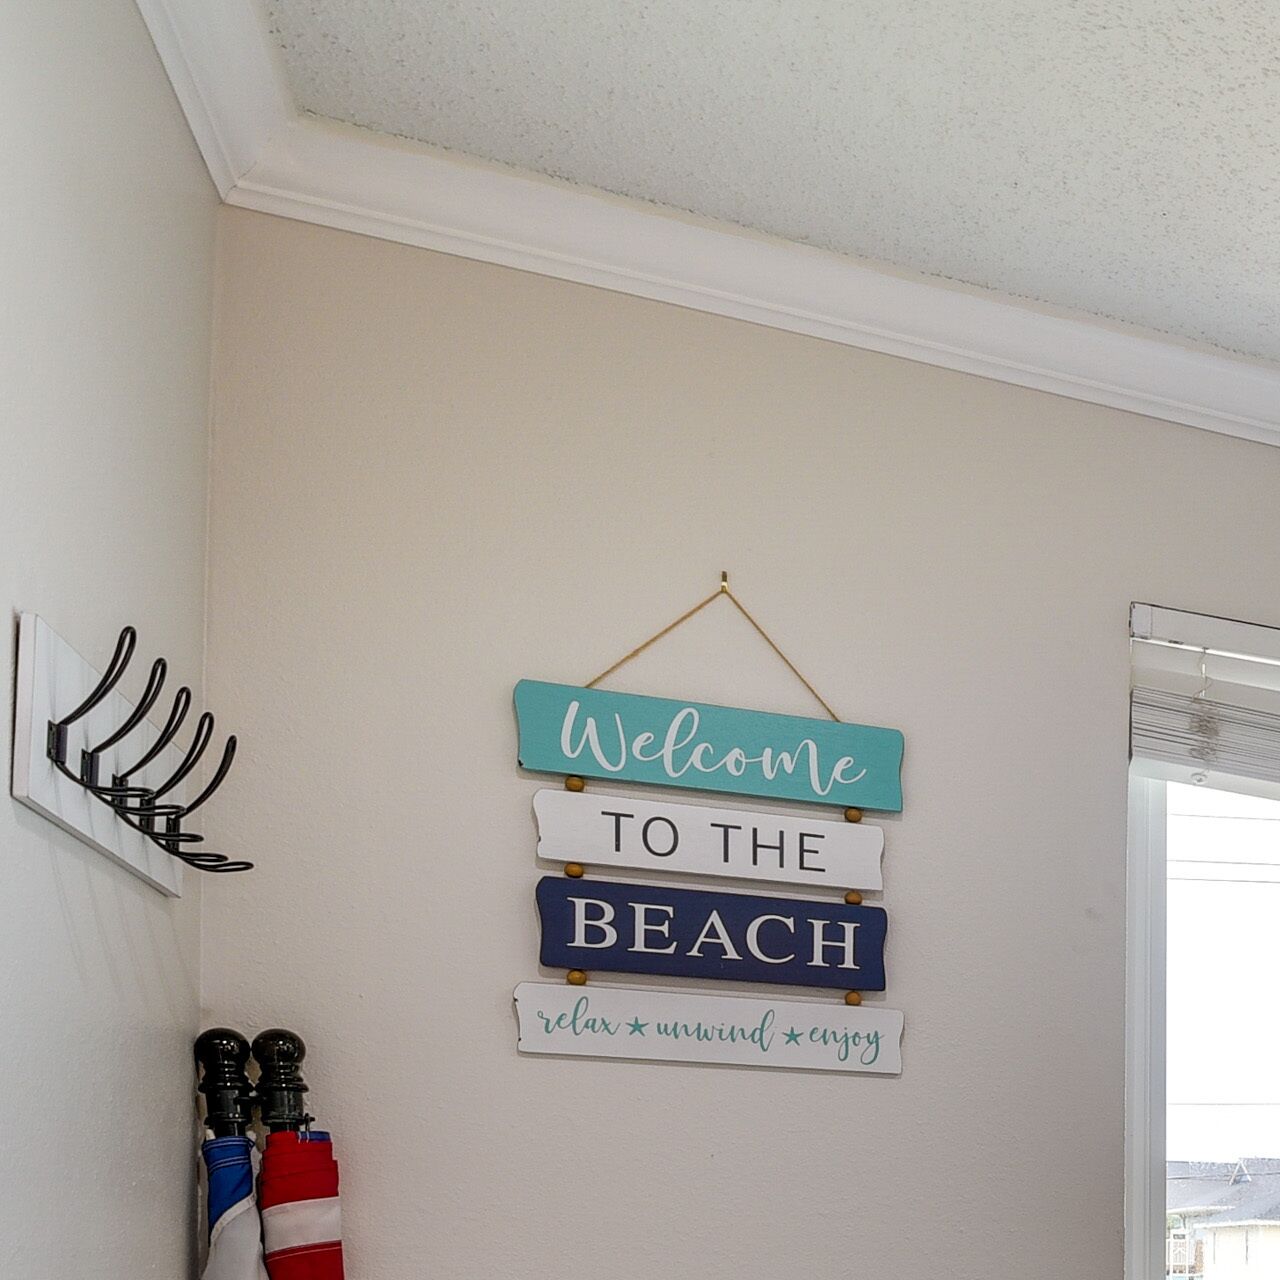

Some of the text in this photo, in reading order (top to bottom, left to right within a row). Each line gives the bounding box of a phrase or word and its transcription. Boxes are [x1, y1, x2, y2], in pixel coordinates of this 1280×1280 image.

[559, 700, 867, 796] Welcome
[600, 811, 826, 873] TO THE
[565, 896, 861, 970] BEACH
[536, 997, 884, 1065] relax unwind enjoy
